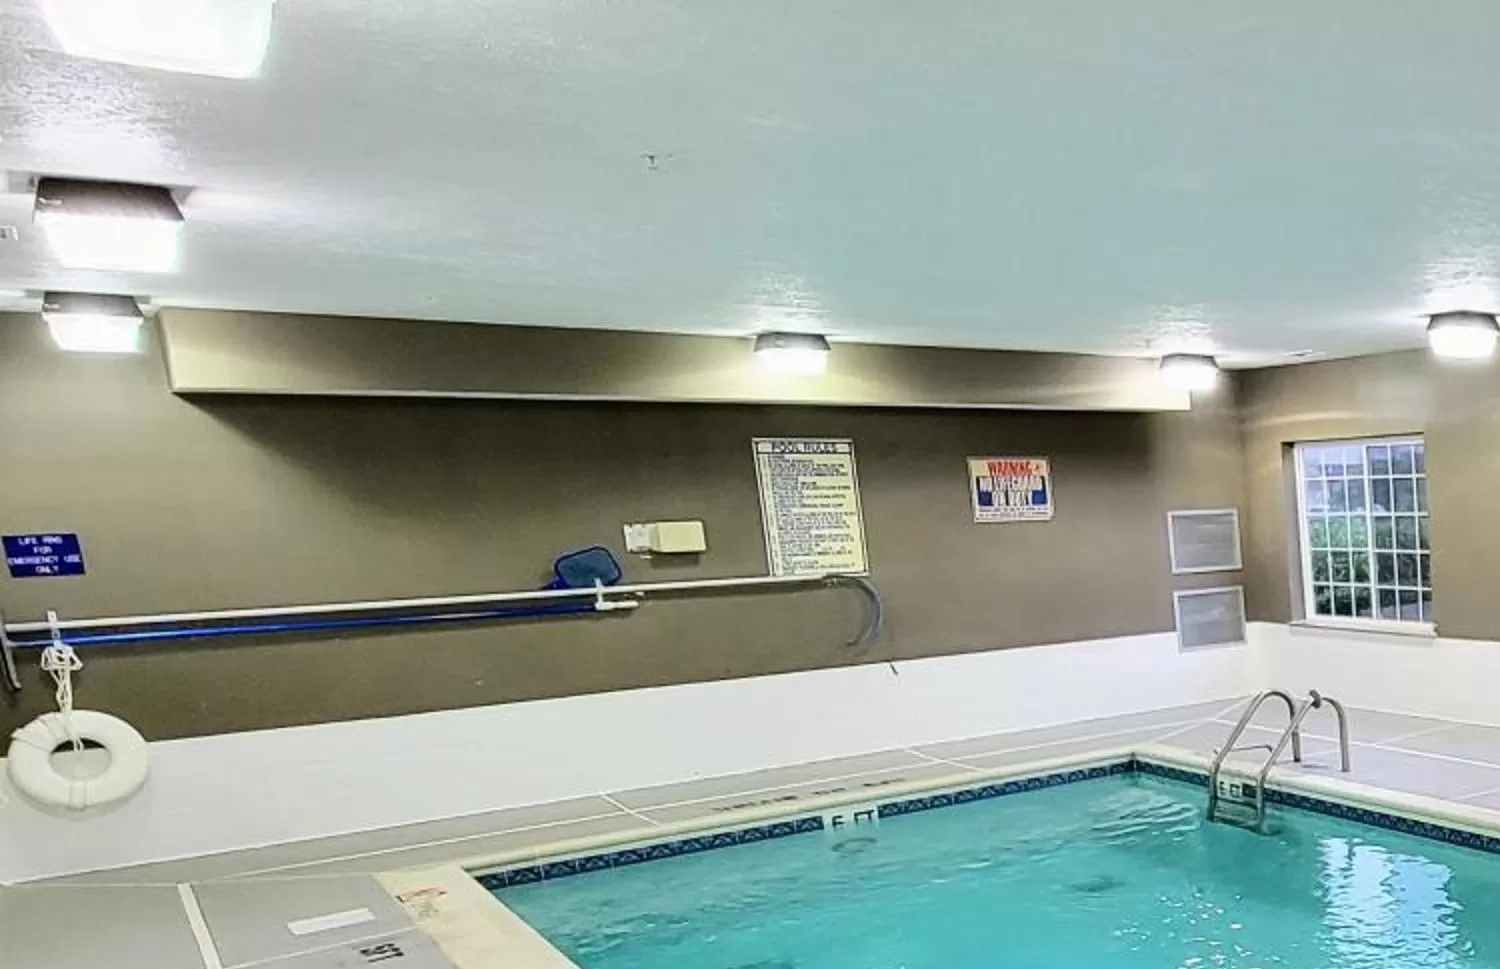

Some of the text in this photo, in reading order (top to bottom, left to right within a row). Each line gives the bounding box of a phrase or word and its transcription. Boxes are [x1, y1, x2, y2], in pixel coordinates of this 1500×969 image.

[772, 441, 800, 453] POOL
[987, 461, 1032, 476] WARNING
[18, 536, 38, 545] LIFE
[33, 546, 52, 554] FOR
